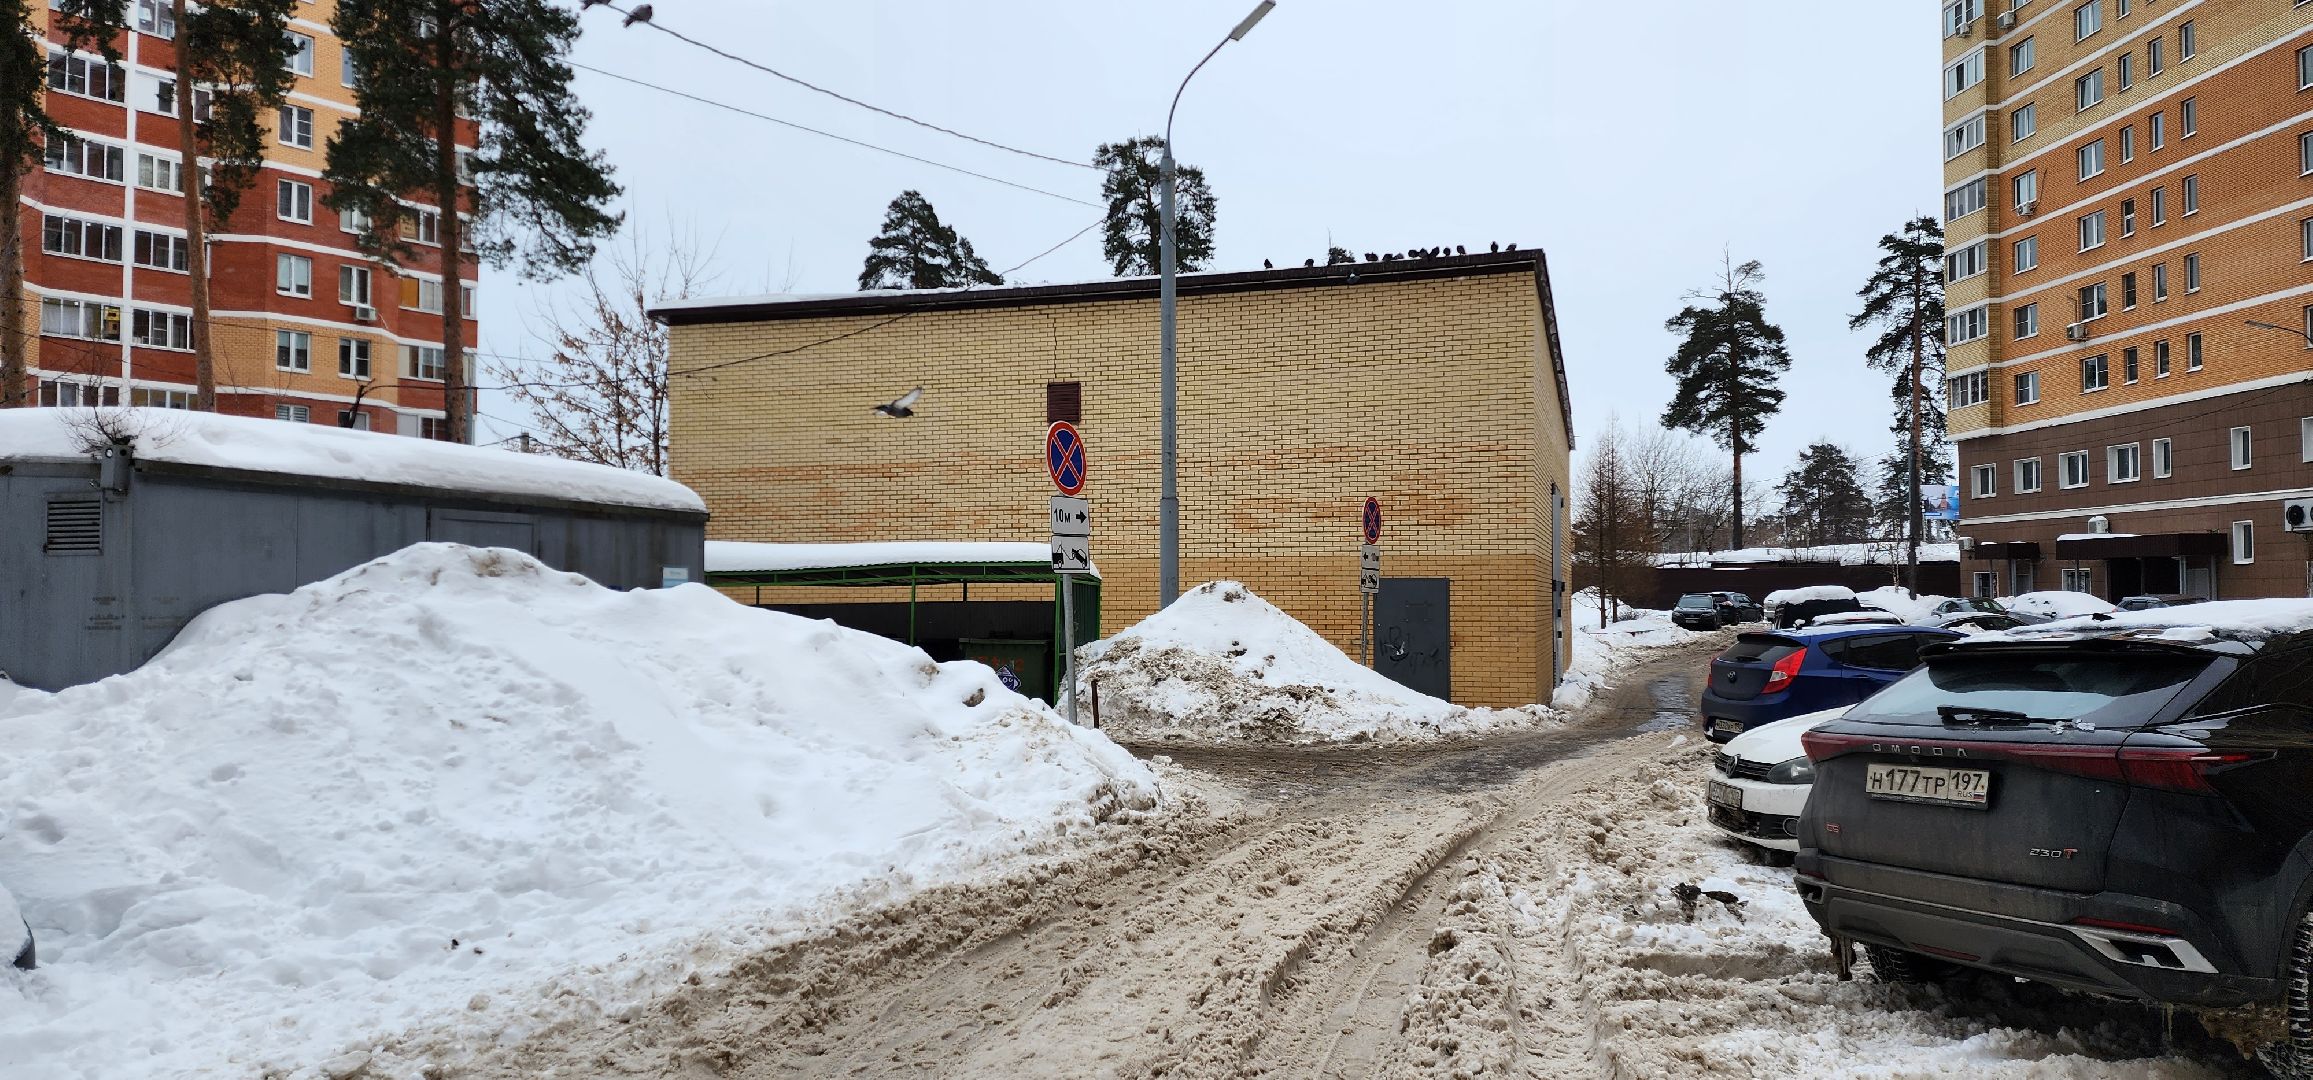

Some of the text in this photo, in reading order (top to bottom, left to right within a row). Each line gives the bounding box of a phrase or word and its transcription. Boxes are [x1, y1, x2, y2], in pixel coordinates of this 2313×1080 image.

[1951, 771, 1983, 791] 197
[1957, 790, 1973, 798] RUS
[2029, 848, 2078, 859] 230T
